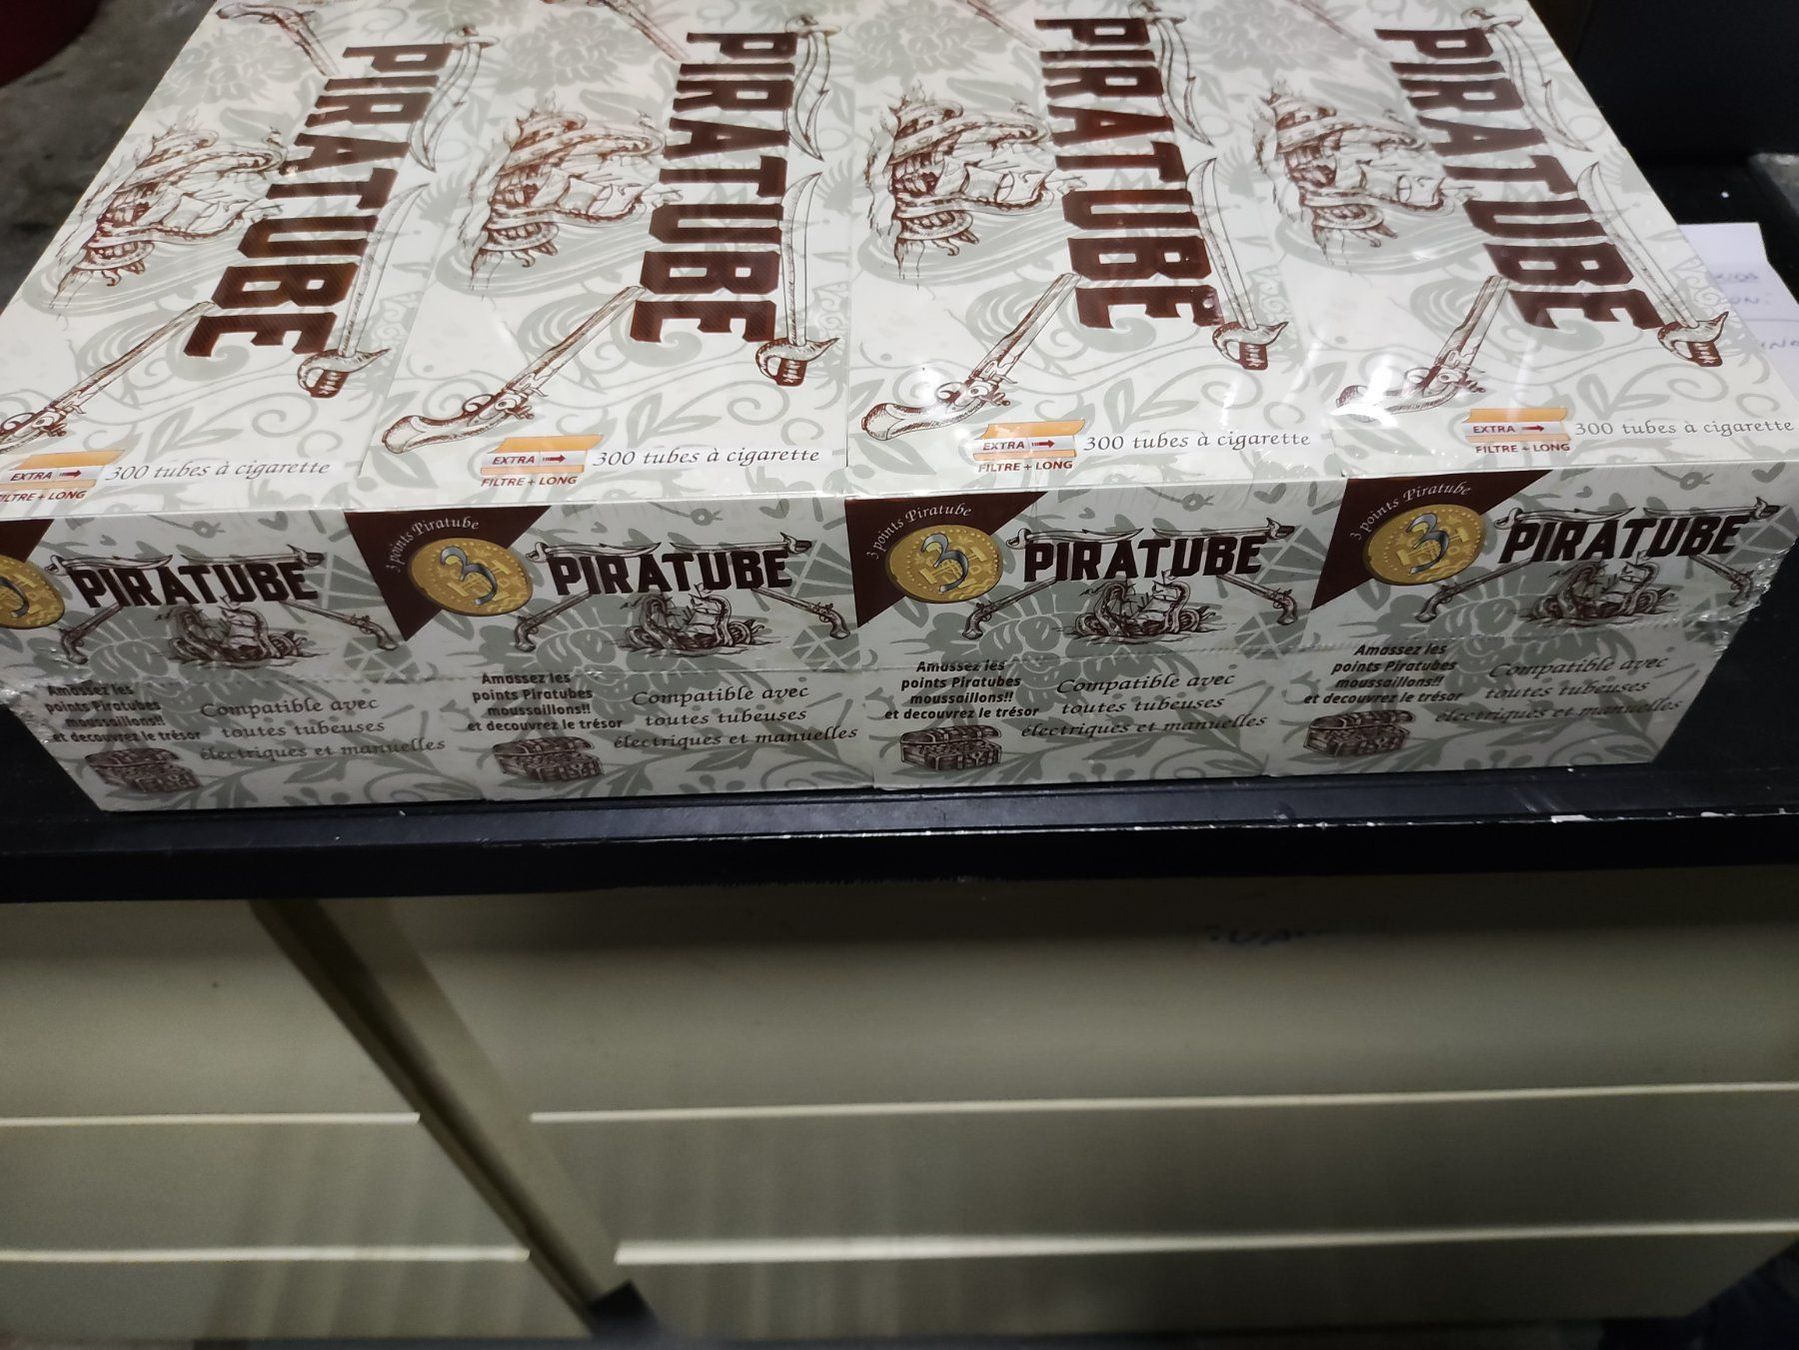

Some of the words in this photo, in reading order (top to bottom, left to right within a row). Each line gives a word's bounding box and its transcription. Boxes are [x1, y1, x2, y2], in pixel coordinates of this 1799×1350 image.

[1035, 18, 1224, 329] PIRATUBE
[1375, 28, 1665, 330] PIRATUBE
[630, 32, 798, 342] PIRATUBE
[184, 43, 454, 356] PIRATUBE
[1473, 425, 1515, 433] EXTRA
[1575, 422, 1613, 436] 300
[1623, 421, 1675, 434] tubes
[1685, 421, 1697, 433] à
[1704, 420, 1794, 436] cigarette
[983, 441, 1025, 450] EXTRA
[1084, 437, 1124, 451] 300
[1133, 434, 1189, 449] tubes
[1197, 434, 1209, 447] à
[1218, 432, 1311, 450] cigarette
[1476, 444, 1518, 453] FILTRE
[1533, 443, 1570, 452] LONG
[493, 455, 535, 465] EXTRA
[593, 451, 635, 466] 300
[644, 449, 699, 464] tubes
[707, 449, 718, 462] à
[726, 448, 819, 466] cigarette
[105, 465, 148, 480] 300
[153, 461, 207, 478] tubes
[216, 462, 229, 476] à
[236, 461, 330, 480] cigarette
[978, 462, 1022, 472] FILTRE
[1036, 461, 1073, 470] LONG
[10, 472, 53, 481] EXTRA
[481, 477, 526, 487] FILTRE
[539, 476, 577, 486] LONG
[49, 490, 87, 500] LONG
[1360, 499, 1399, 533] points
[1403, 480, 1472, 503] Piratube
[873, 519, 904, 553] points
[905, 503, 972, 523] Piratube
[390, 531, 414, 565] points
[413, 516, 480, 536] Piratube
[1405, 512, 1450, 576] 3
[1498, 514, 1751, 564] PIRATUBE
[920, 532, 969, 594] 3
[1023, 535, 1268, 583] PIRATUBE
[440, 545, 498, 605] 3
[545, 549, 793, 596] PIRATUBE
[65, 562, 319, 608] PIRATUBE
[1354, 644, 1420, 656] Amassez
[1424, 643, 1447, 654] les
[1331, 660, 1381, 675] points
[1384, 659, 1457, 672] Piratubes
[1488, 656, 1614, 680] Compatible
[1619, 656, 1668, 670] avec
[482, 672, 545, 684] Amassez
[550, 672, 571, 683] les
[901, 678, 947, 691] points
[951, 676, 1021, 688] Piratubes
[1056, 672, 1180, 695] Compatible
[1186, 673, 1235, 688] avec
[1335, 675, 1444, 688] moussaillons!!
[472, 690, 518, 703] points
[523, 687, 593, 700] Piratubes
[632, 686, 758, 707] Compatible
[762, 687, 809, 700] avec
[910, 692, 1013, 704] moussaillons!!
[1304, 694, 1320, 704] et
[1323, 693, 1398, 704] decouvrez
[1400, 691, 1413, 702] le
[1417, 690, 1464, 702] trésor
[1485, 687, 1553, 700] toutes
[1558, 681, 1650, 696] tubeuses
[200, 697, 323, 718] Compatible
[331, 698, 379, 711] avec
[487, 704, 591, 716] moussaillons!!
[884, 710, 899, 719] et
[903, 708, 975, 719] decouvrez
[979, 708, 991, 718] le
[996, 706, 1039, 717] trésor
[1061, 702, 1126, 715] toutes
[1134, 697, 1225, 712] tubeuses
[1551, 707, 1572, 719] et
[467, 722, 482, 731] et
[486, 720, 558, 731] decouvrez
[562, 719, 575, 729] le
[579, 718, 623, 729] trésor
[645, 714, 709, 726] toutes
[718, 708, 807, 724] tubeuses
[1021, 722, 1129, 739] électriques
[1137, 722, 1157, 733] et
[1163, 713, 1267, 732] manuelles
[222, 726, 286, 738] toutes
[294, 721, 384, 735] tubeuses
[613, 735, 721, 749] électriques
[729, 734, 747, 745] et
[755, 726, 858, 744] manuelles
[200, 746, 307, 762] électriques
[315, 746, 336, 756] et
[341, 738, 445, 756] manuelles
